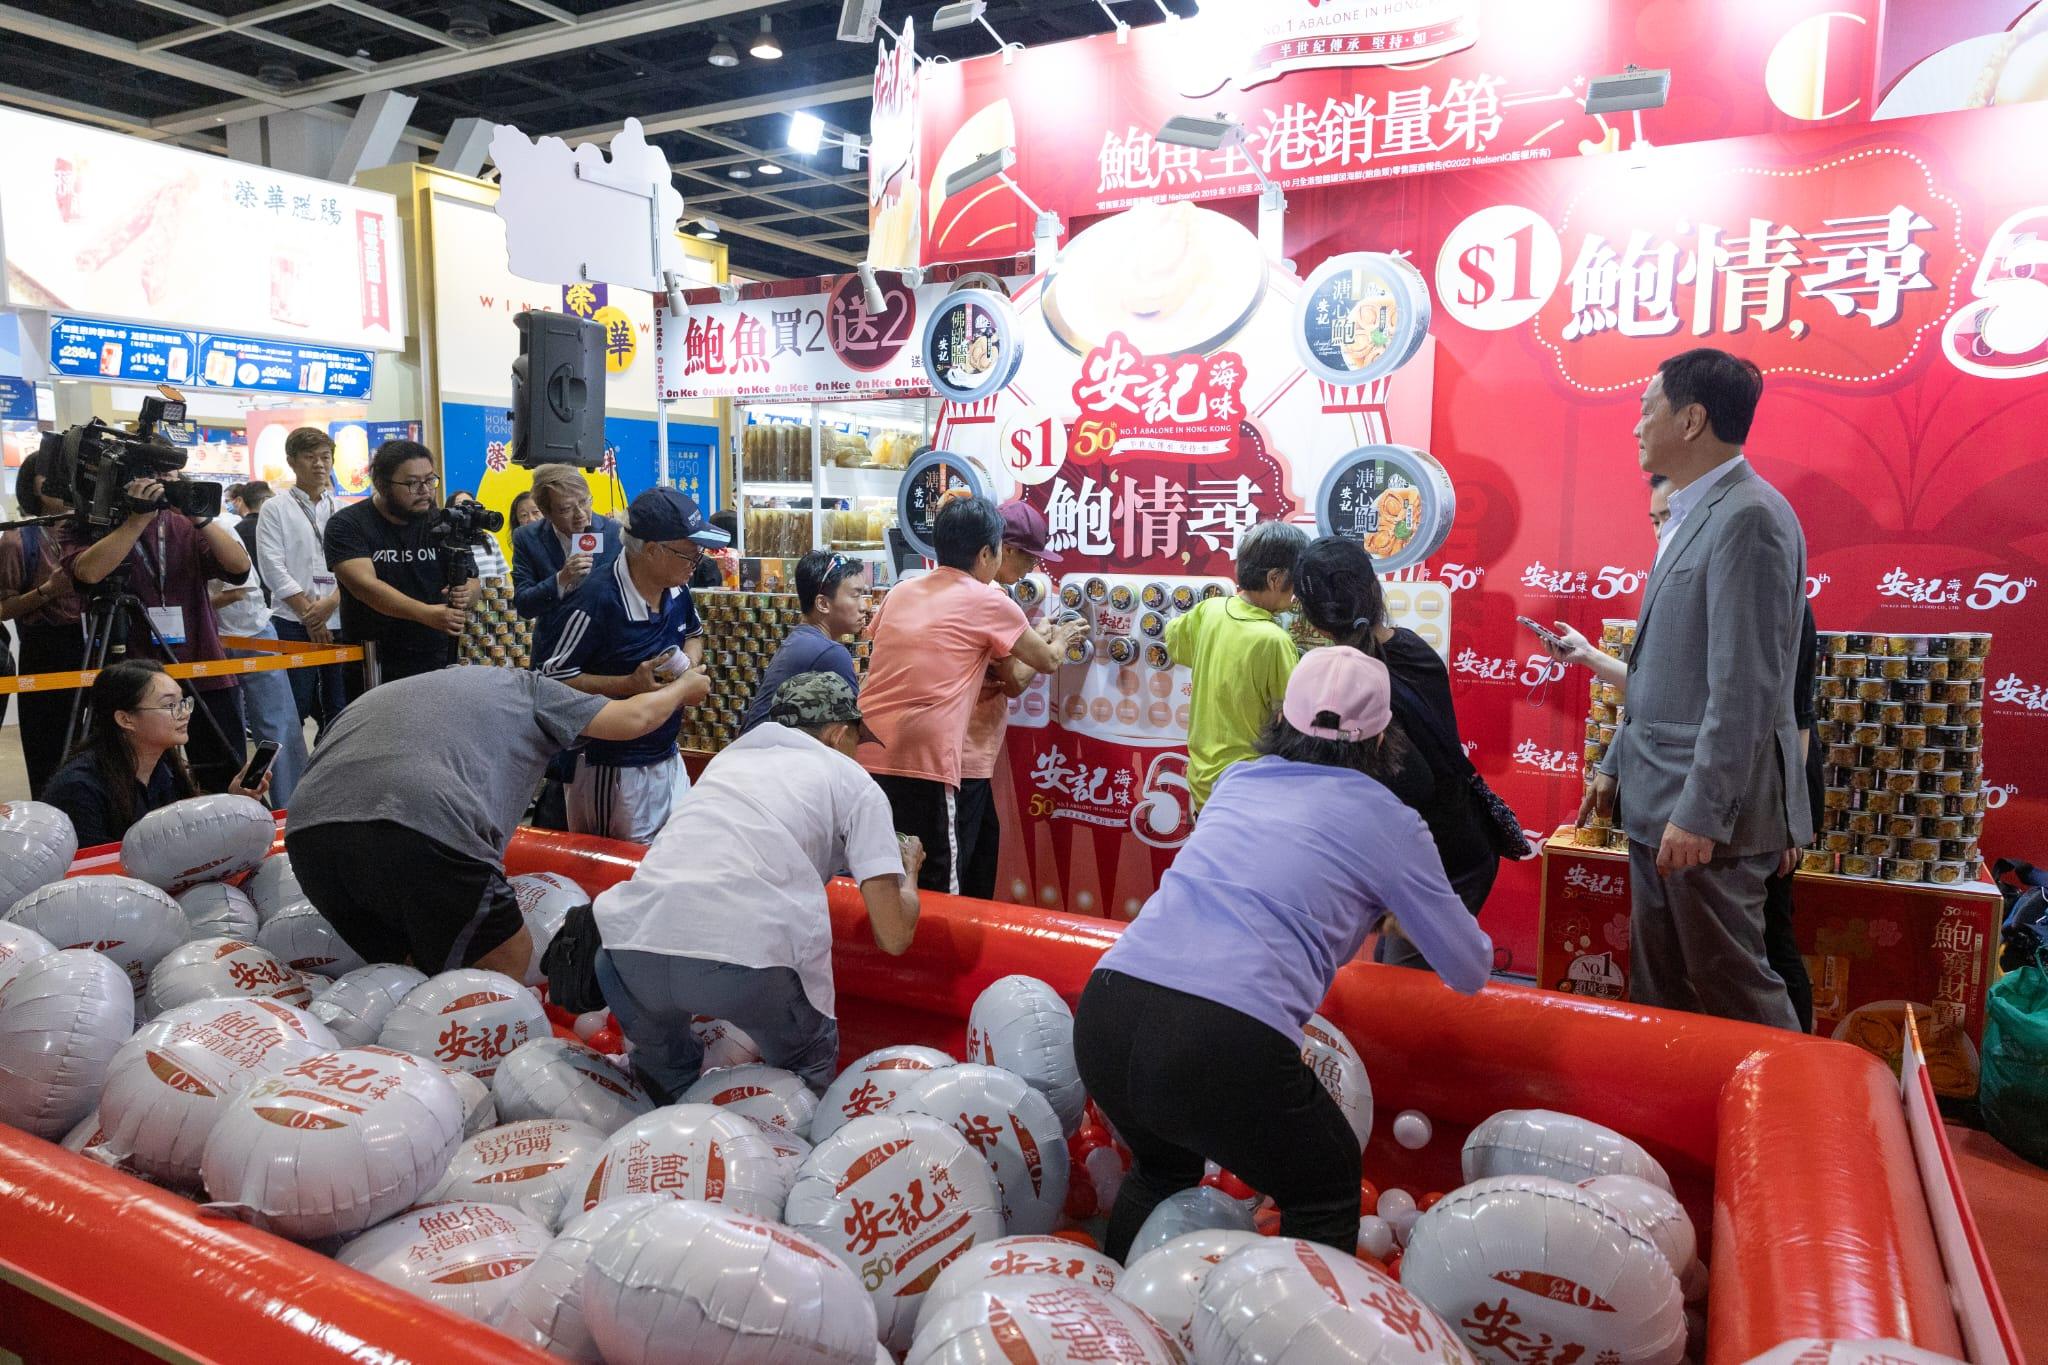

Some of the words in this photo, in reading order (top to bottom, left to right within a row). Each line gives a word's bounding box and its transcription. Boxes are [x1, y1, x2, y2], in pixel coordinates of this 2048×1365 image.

[1457, 223, 1542, 309] $1
[607, 320, 635, 367] 華
[1077, 340, 1208, 424] 安記
[1010, 417, 1058, 471] $1
[401, 549, 413, 563] IS
[417, 547, 437, 561] ON
[1520, 560, 1576, 593] 安記
[1576, 571, 1589, 593] 海味
[1591, 565, 1648, 600] 50th
[1876, 566, 1946, 604] 安記
[1946, 579, 1963, 604] 海味
[1965, 572, 2037, 610] 50th
[1452, 648, 1505, 680] 安記
[1030, 744, 1114, 805] 安記
[1114, 769, 1134, 806] 海味
[1512, 738, 1567, 772] 安記
[1564, 863, 1615, 894] 安記
[229, 959, 293, 990] 安記
[203, 1010, 283, 1055] 鮑魚
[434, 1019, 516, 1063] 安記
[650, 1153, 690, 1200] 鮑
[844, 1178, 946, 1256] 安記
